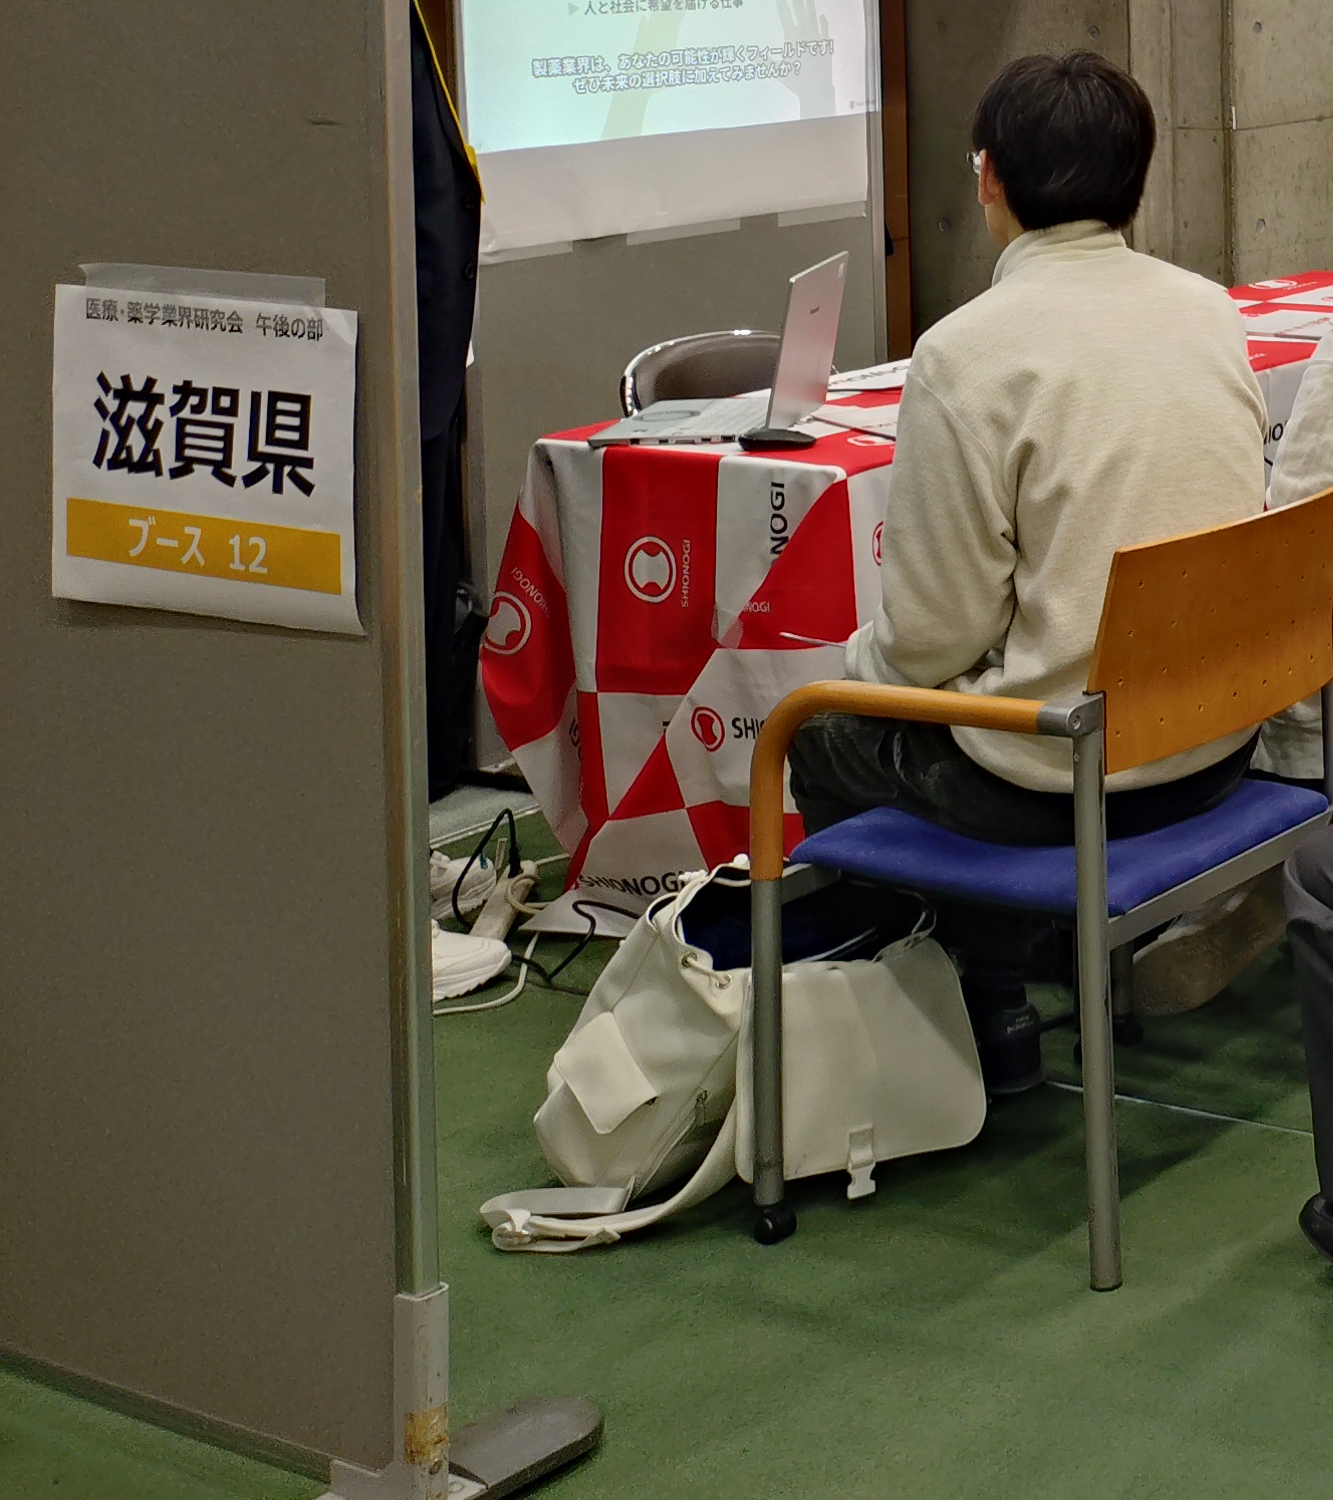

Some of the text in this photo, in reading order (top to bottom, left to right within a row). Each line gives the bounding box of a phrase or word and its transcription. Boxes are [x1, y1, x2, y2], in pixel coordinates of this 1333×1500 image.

[86, 297, 323, 341] 医療・薬学業界研究会 午後の部
[92, 371, 316, 497] 滋賀県
[128, 515, 268, 574] ブース 12
[681, 539, 691, 607] SHIONOGI
